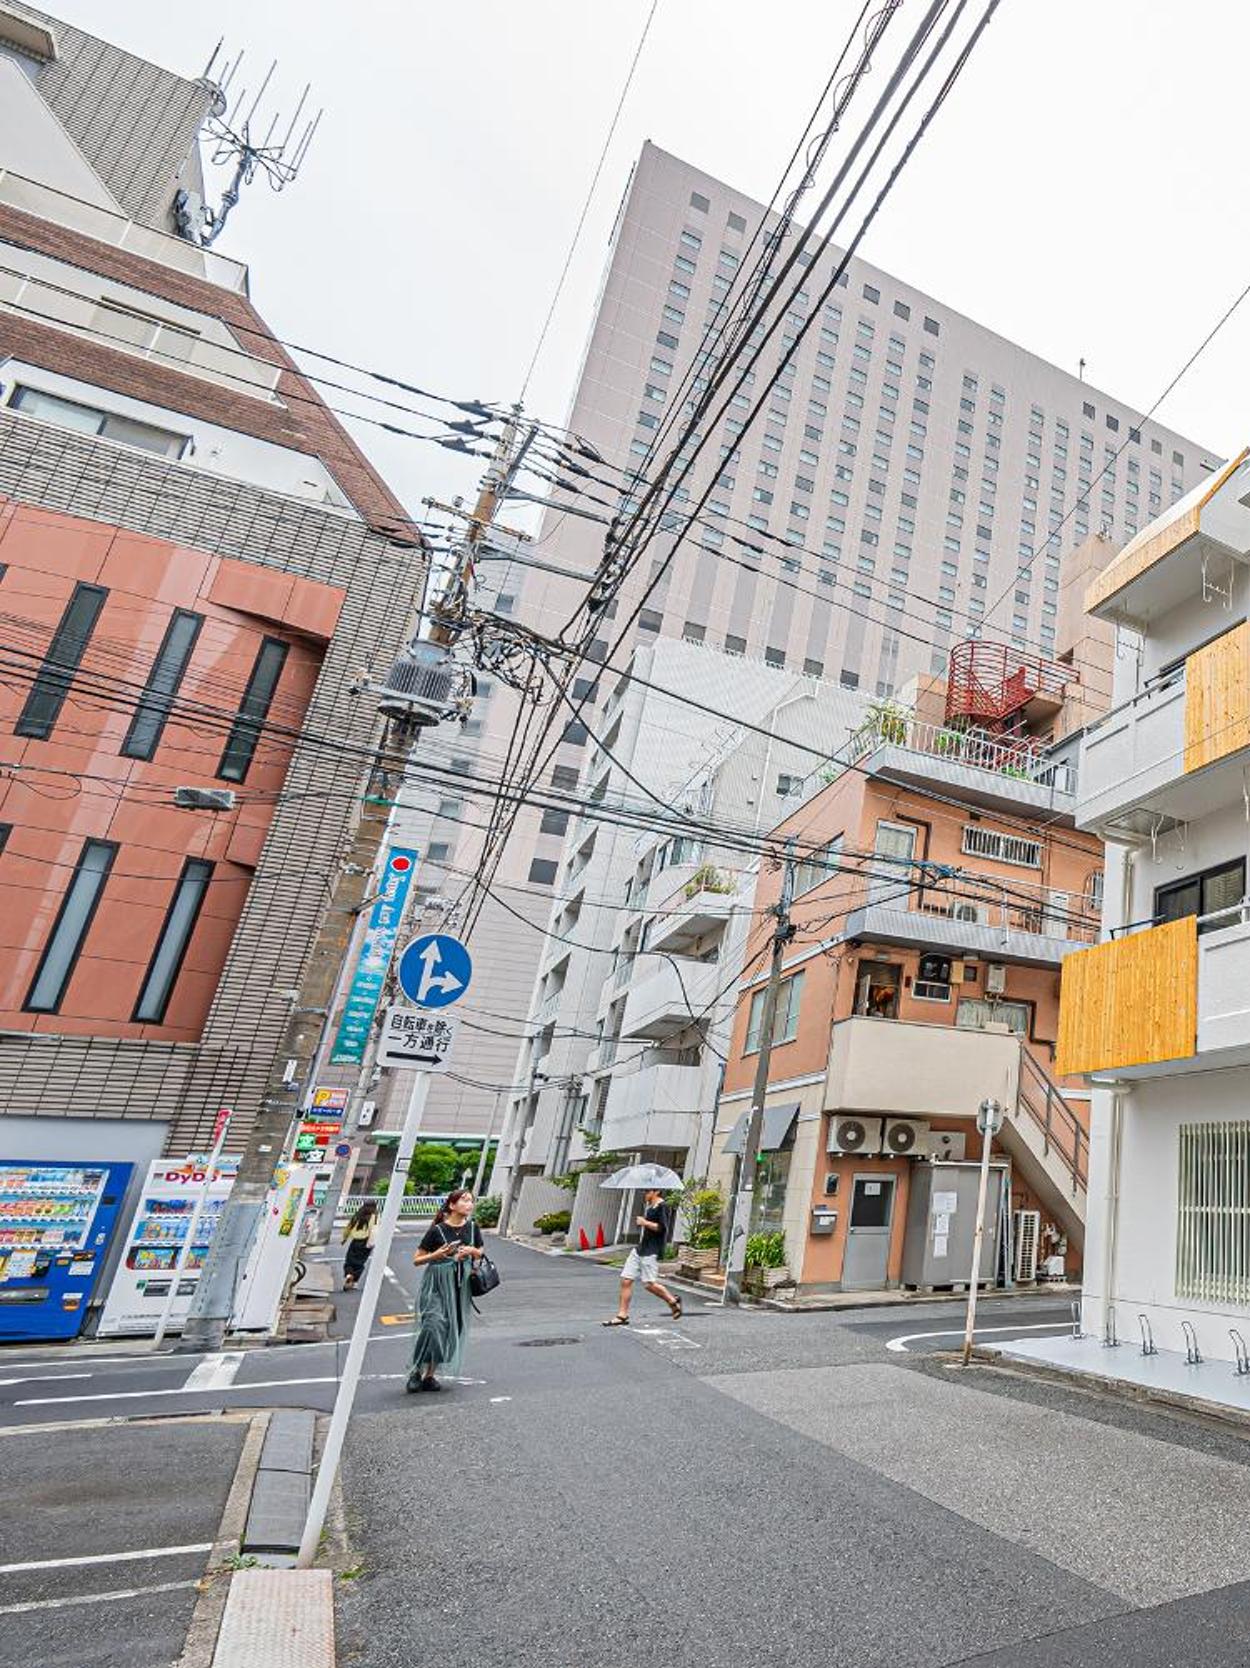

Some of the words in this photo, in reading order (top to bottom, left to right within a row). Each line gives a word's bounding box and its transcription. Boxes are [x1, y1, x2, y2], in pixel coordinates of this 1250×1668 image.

[390, 1014, 453, 1036] 自転車を除く
[387, 1033, 451, 1053] 一方通行
